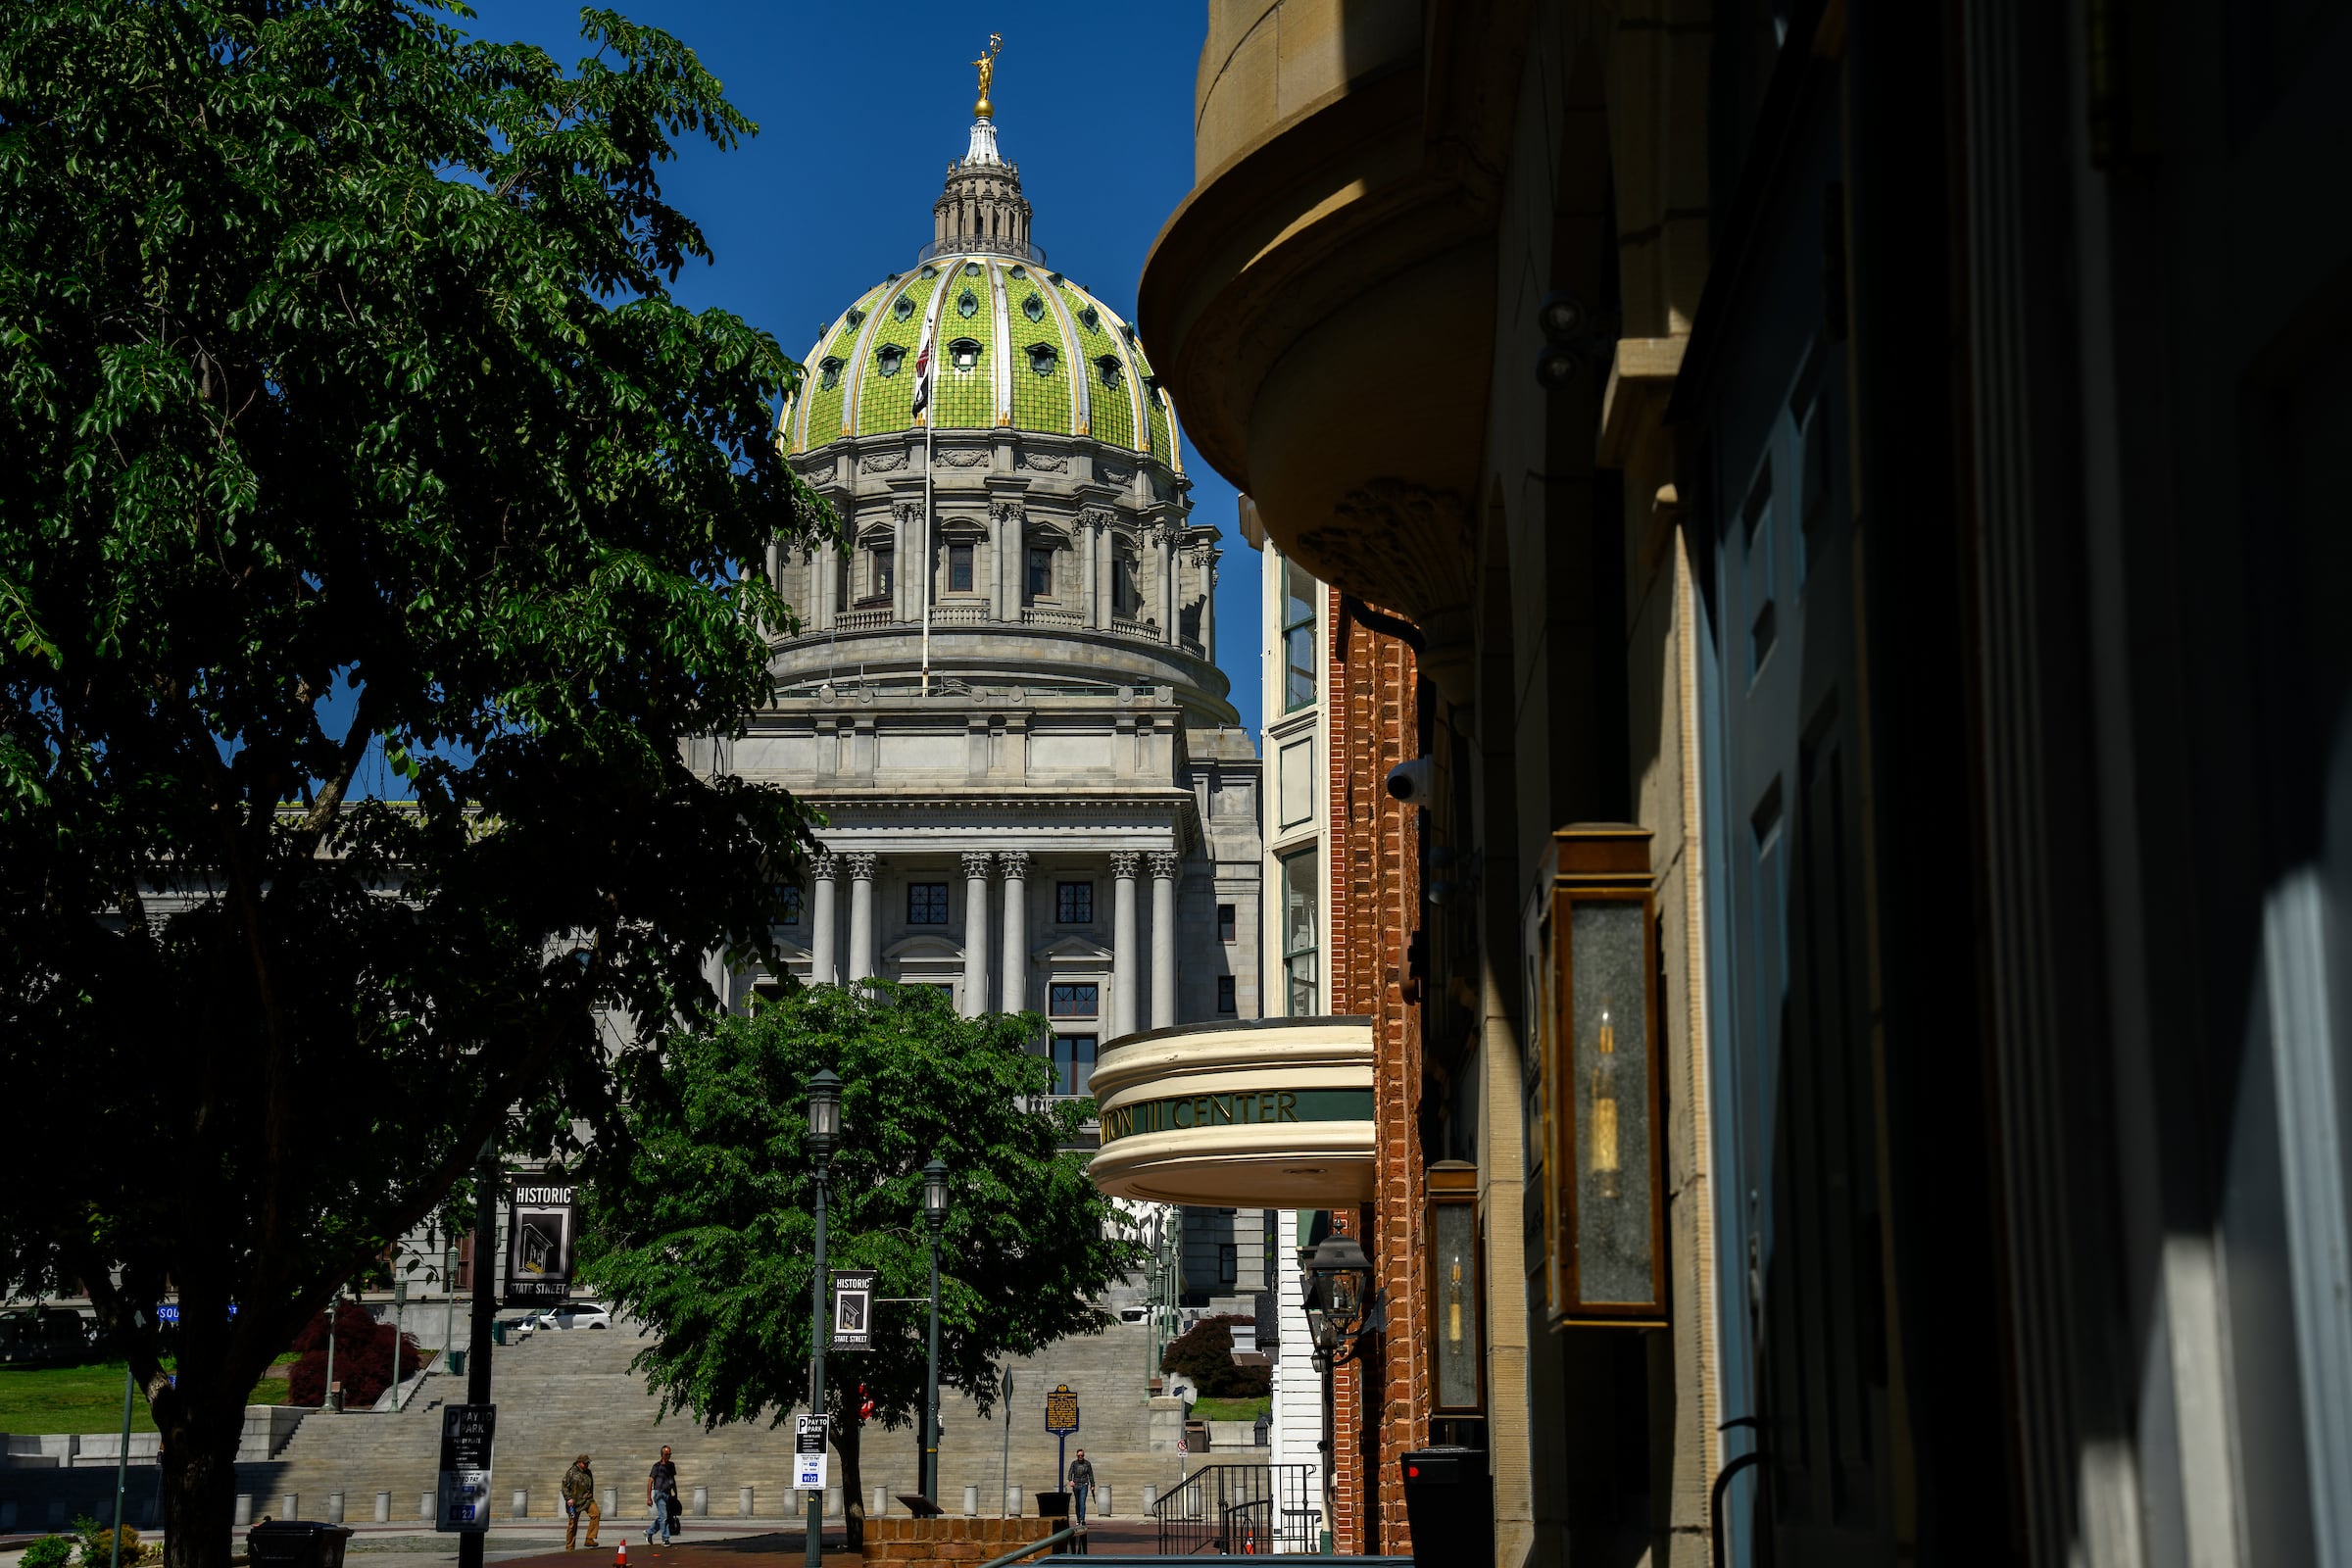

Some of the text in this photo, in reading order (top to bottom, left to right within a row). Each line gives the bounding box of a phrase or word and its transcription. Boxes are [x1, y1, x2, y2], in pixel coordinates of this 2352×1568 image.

[1173, 1091, 1299, 1130] CENTER
[515, 1187, 571, 1203] HISTORIC
[510, 1283, 566, 1295] STATE STREET
[836, 1278, 869, 1289] HISTORIC
[448, 1411, 459, 1433] P
[462, 1411, 493, 1422] PAY TO
[461, 1423, 484, 1434] PARK
[800, 1419, 807, 1432] P
